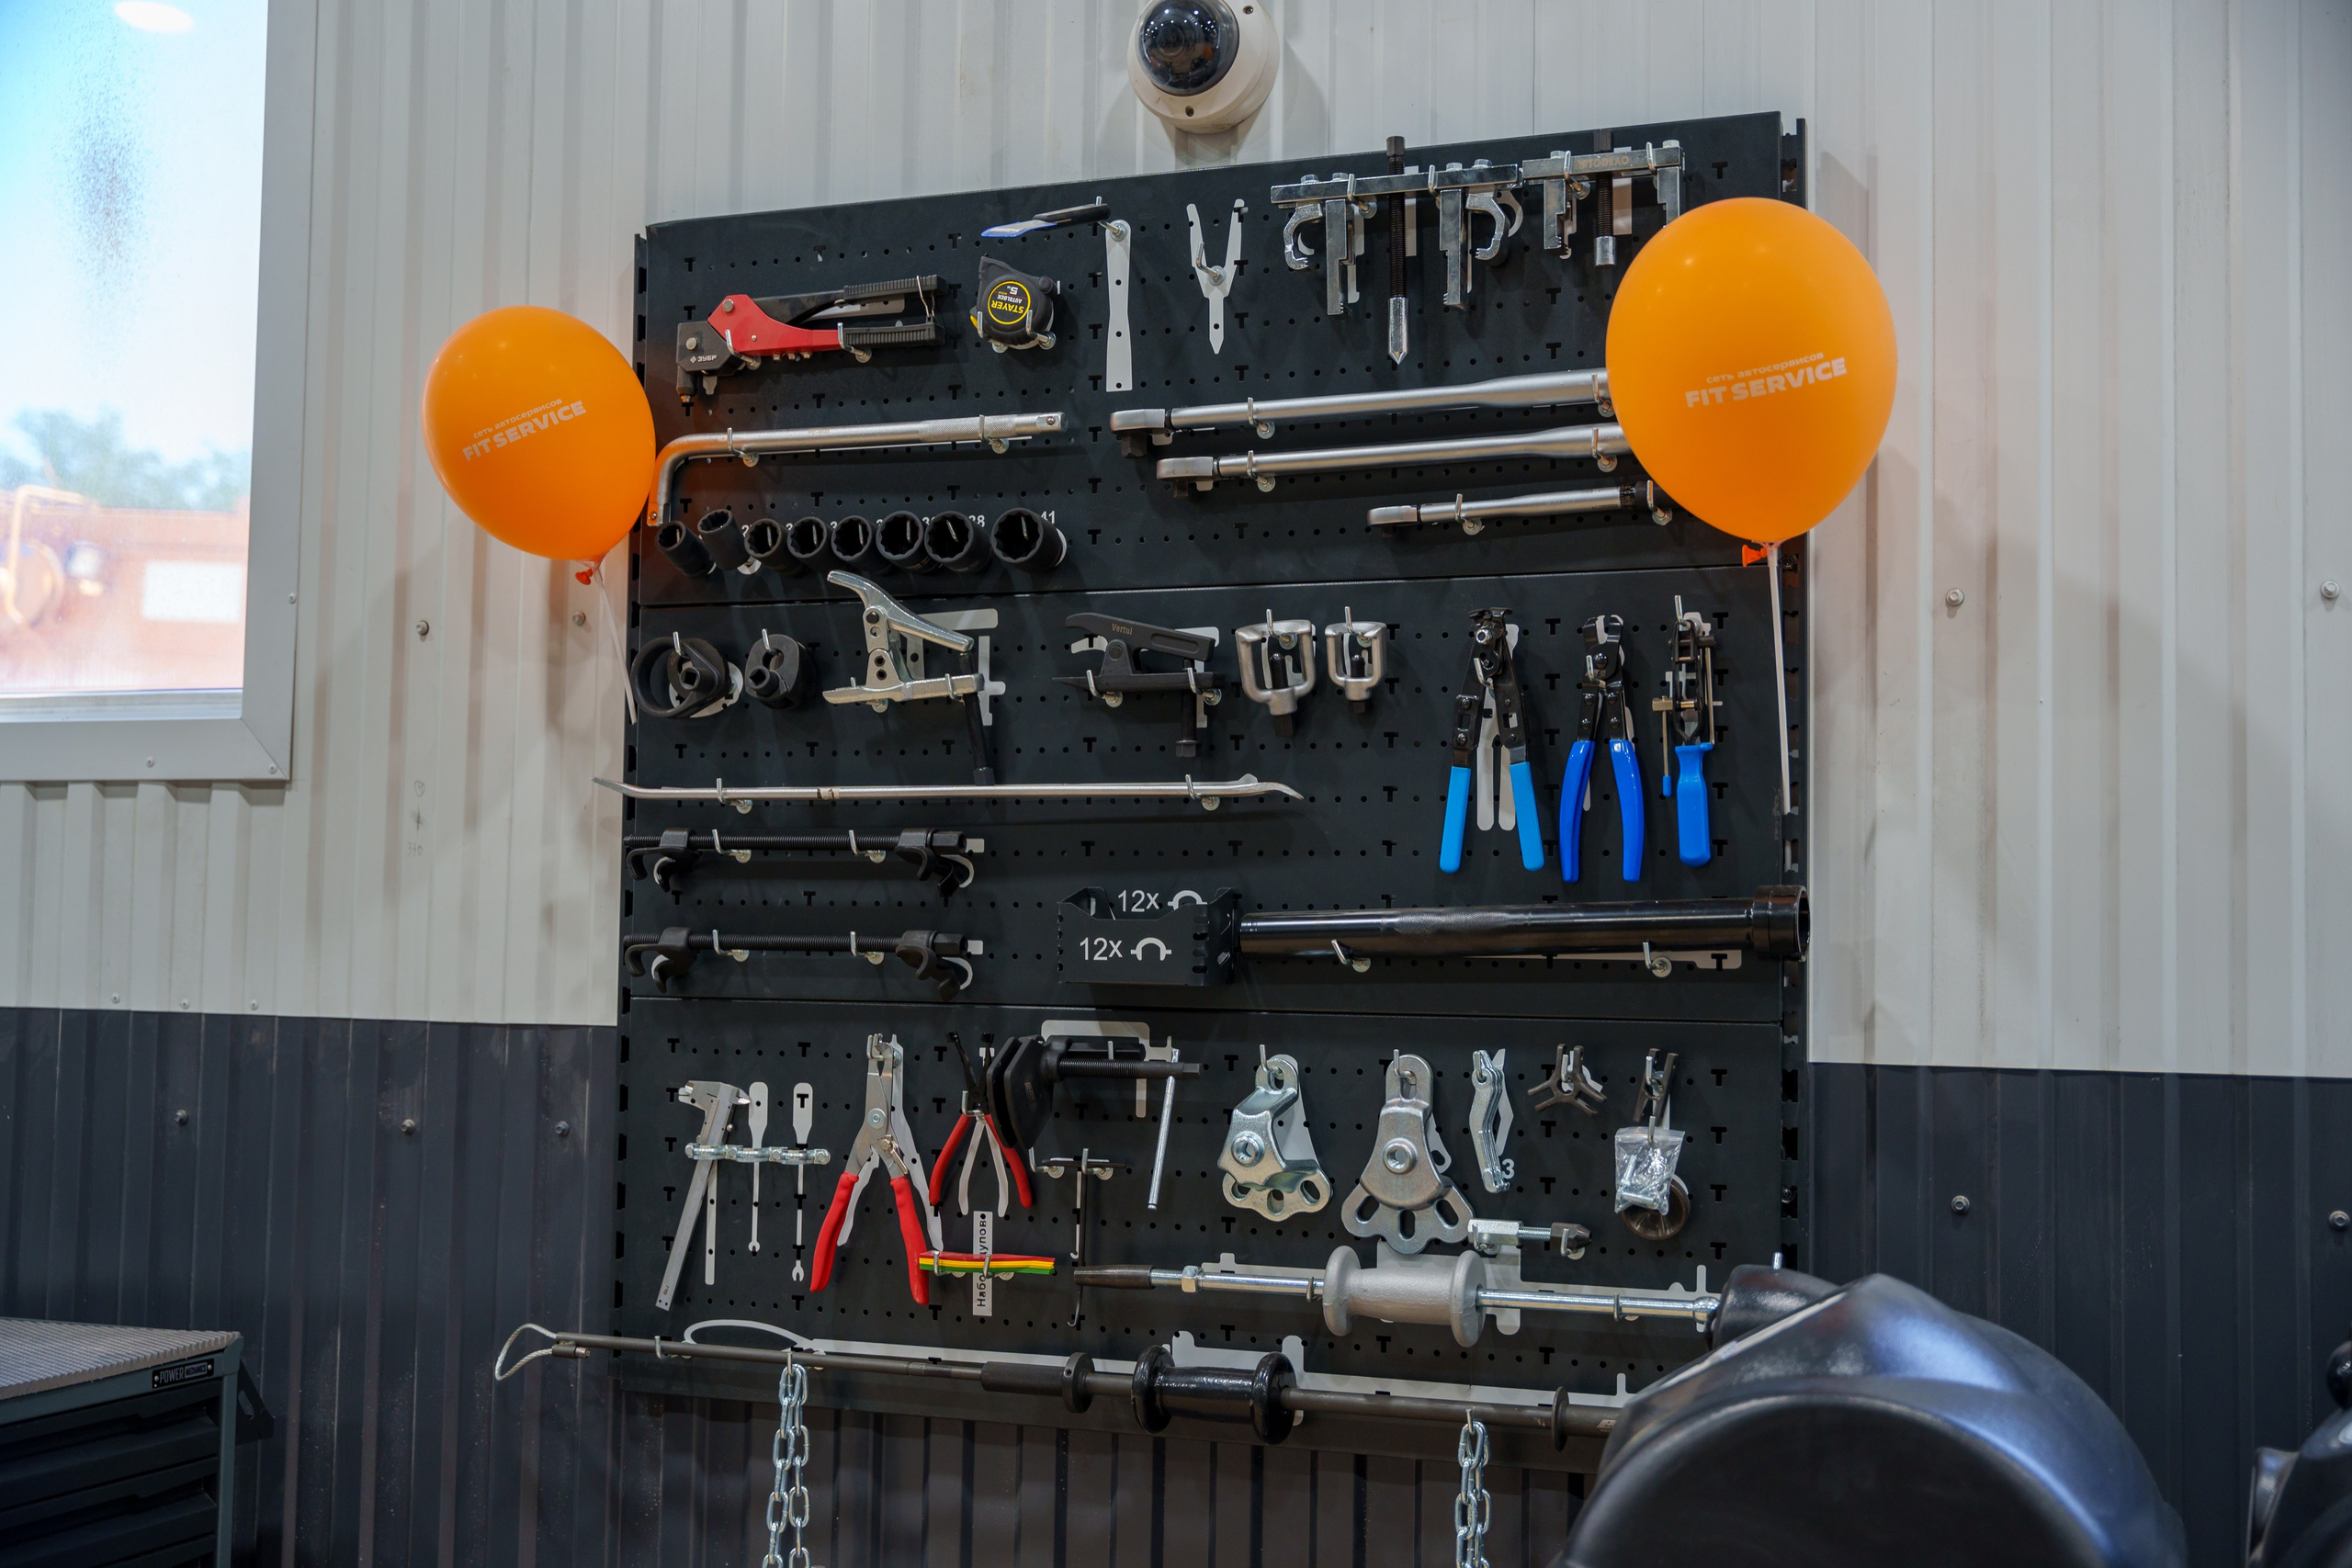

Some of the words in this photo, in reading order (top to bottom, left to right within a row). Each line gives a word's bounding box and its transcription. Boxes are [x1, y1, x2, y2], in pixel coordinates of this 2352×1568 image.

[991, 299, 1024, 314] STAYER
[997, 294, 1023, 304] AUTOLOCK
[697, 355, 717, 363] ЗУБР
[1706, 373, 1734, 384] сеть
[1737, 352, 1825, 378] автосервисов
[1685, 386, 1727, 408] FIT
[1731, 356, 1848, 401] SERVICE
[473, 427, 489, 439] сеть
[494, 398, 563, 430] автосервисов
[462, 437, 491, 462] FIT
[492, 400, 587, 448] SERVICE
[1112, 623, 1133, 635] Vertul
[1501, 1158, 1515, 1179] 3
[977, 1273, 986, 1307] Набо
[159, 1367, 185, 1384] POWER
